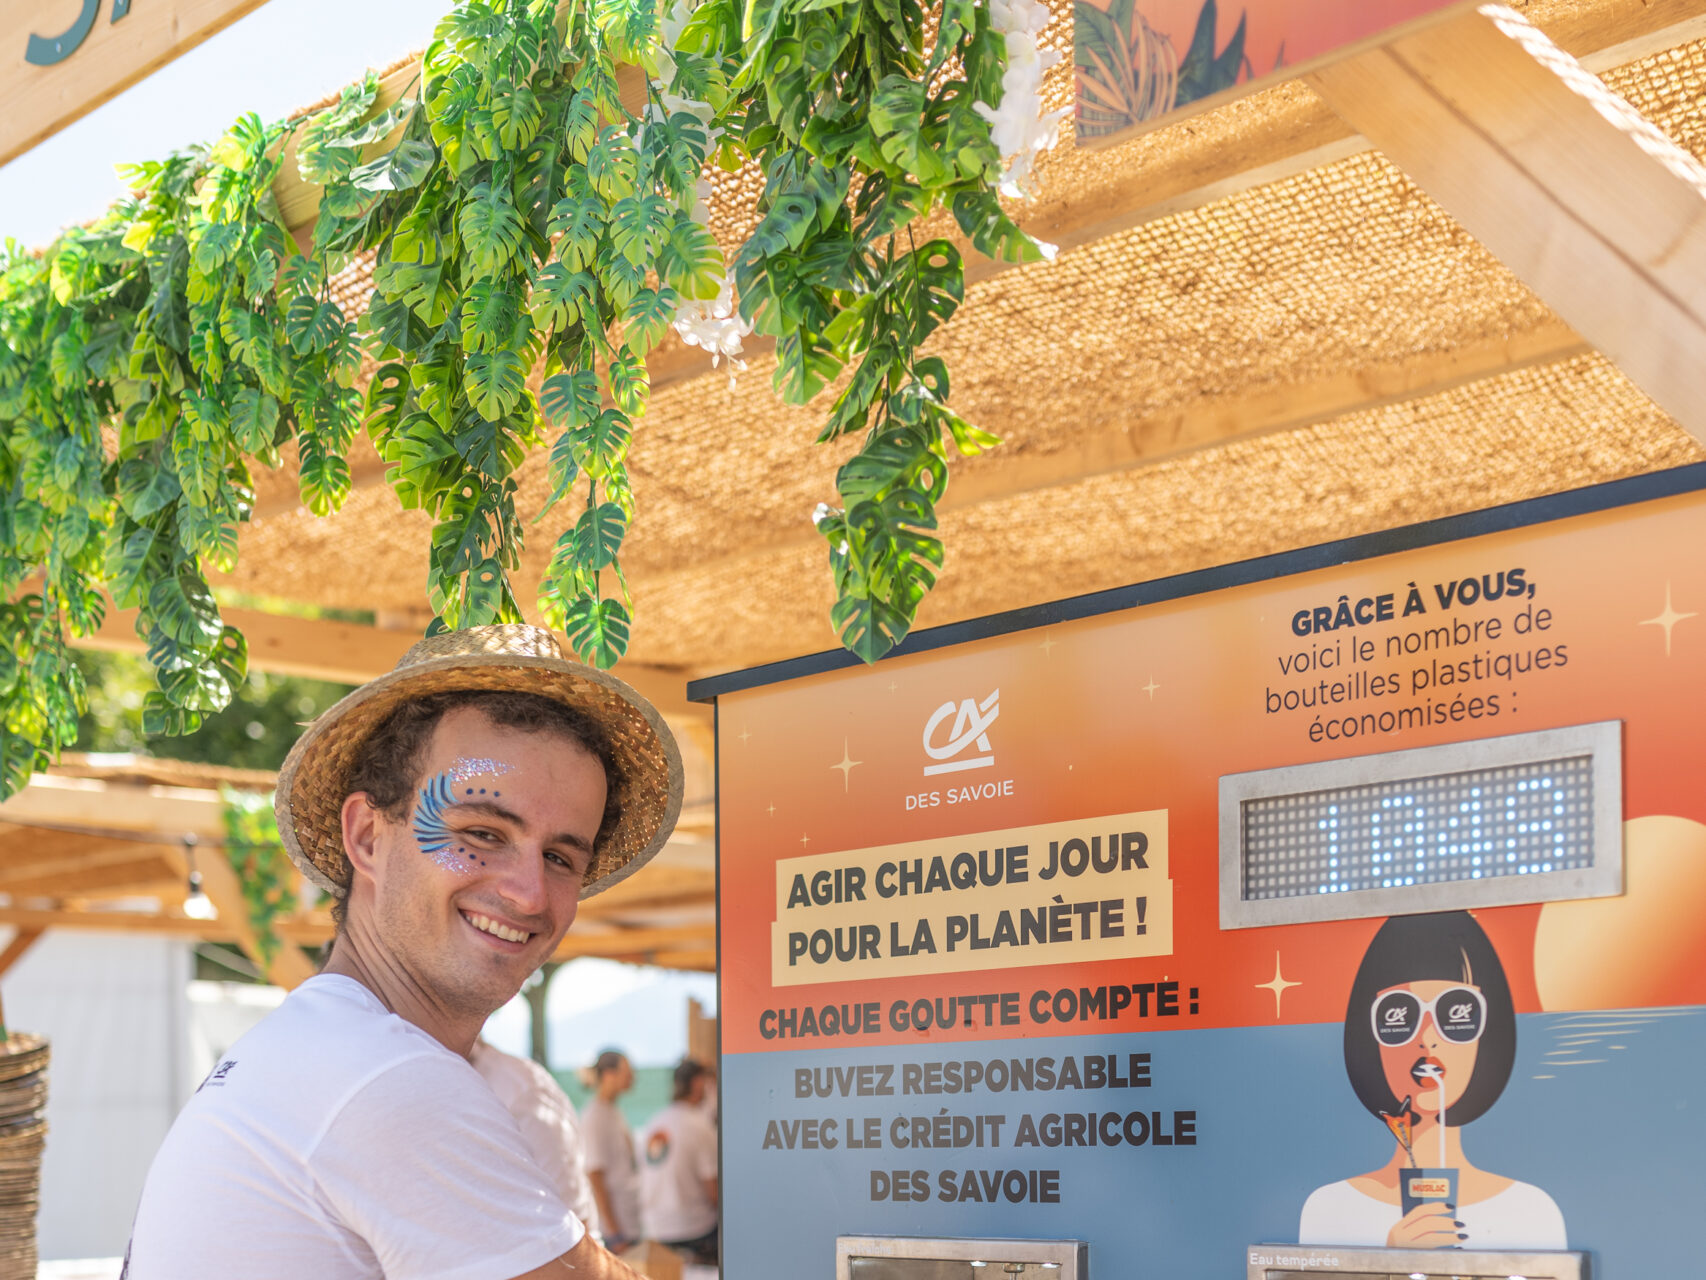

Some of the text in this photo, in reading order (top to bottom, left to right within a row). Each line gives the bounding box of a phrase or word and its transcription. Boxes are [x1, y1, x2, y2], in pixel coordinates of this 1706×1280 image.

[1291, 567, 1537, 637] GRÂCE À VOUS,
[1278, 603, 1553, 676] voici le nombre de
[1266, 640, 1568, 714] bouteilles plastiques
[1308, 691, 1501, 743] économisées
[906, 779, 1014, 811] DES SAVOIE
[1318, 776, 1565, 894] 1048
[786, 832, 1149, 909] AGIR CHAQUE JOUR
[789, 924, 882, 966] POUR
[890, 919, 937, 957] LA
[946, 894, 1125, 952] PLANÈTE
[759, 1003, 880, 1040] CHAQUE
[889, 992, 1020, 1034] GOUTTE
[1029, 982, 1179, 1024] COMPTE
[795, 1053, 1152, 1099] BUVEZ RESPONSABLE
[762, 1107, 1197, 1150] AVEC LE CRÉDIT AGRICOLE
[870, 1170, 1060, 1204] DES SAVOIE
[1249, 1252, 1339, 1271] Eau tempérée
